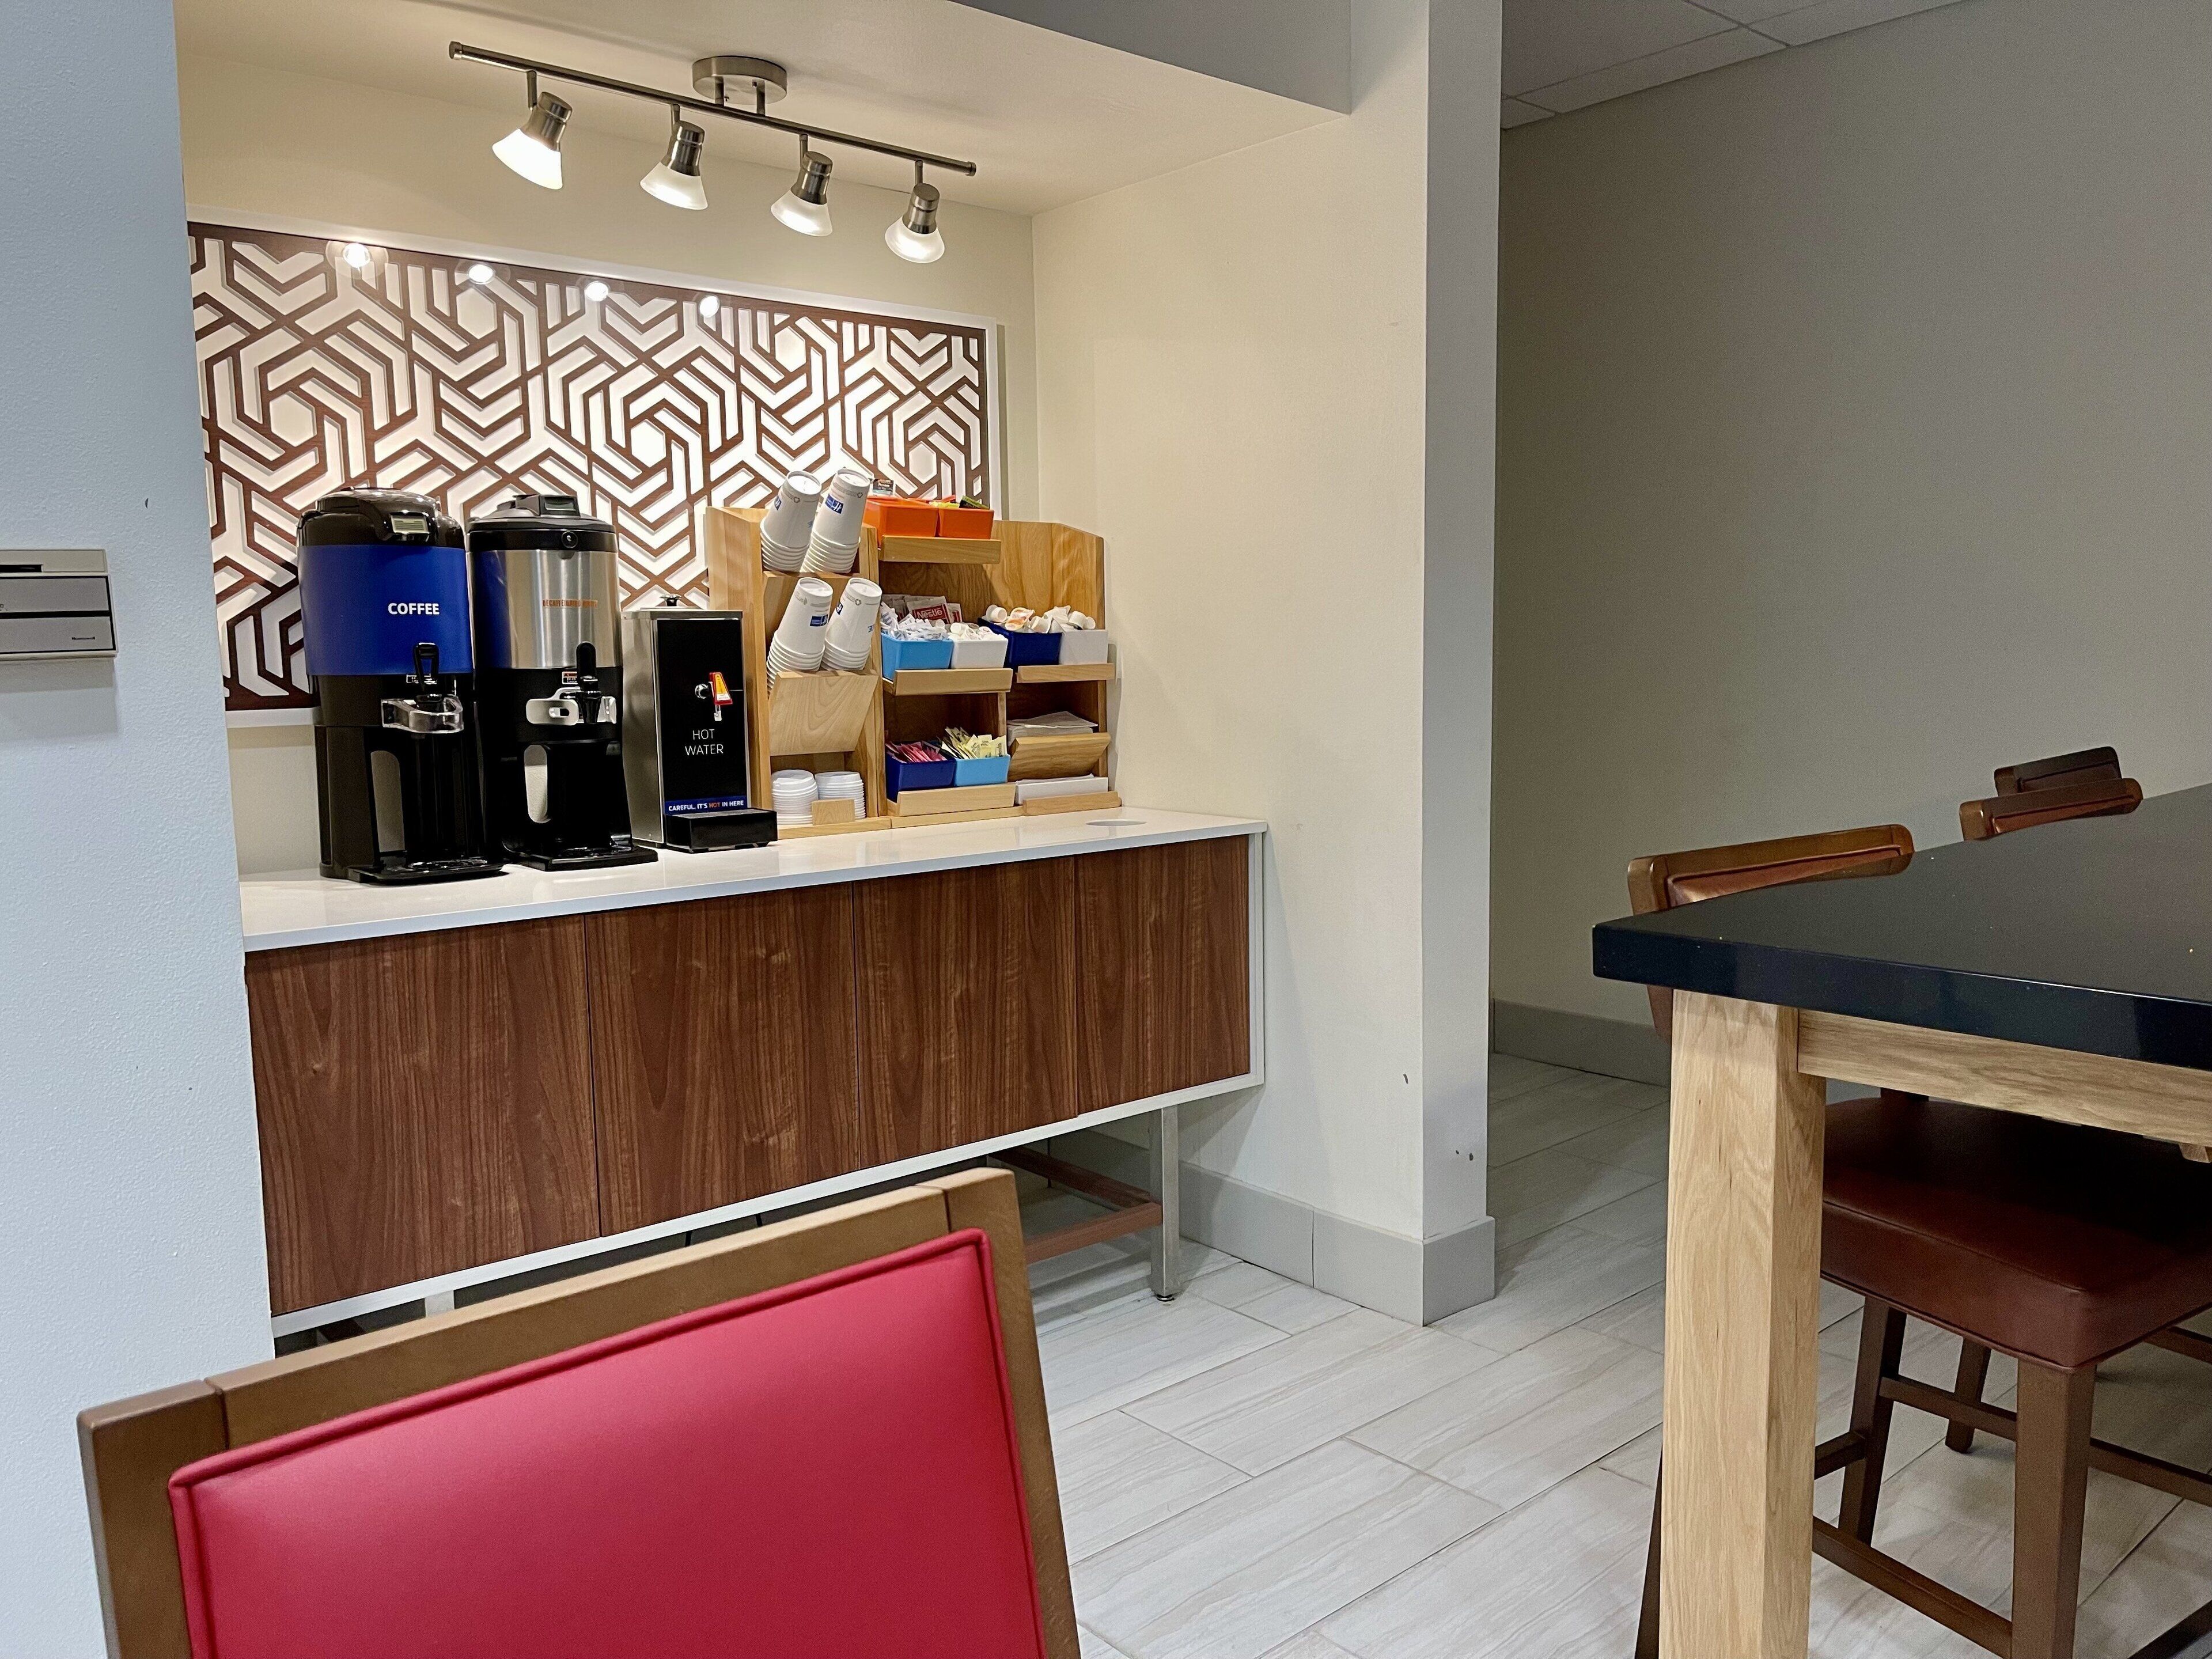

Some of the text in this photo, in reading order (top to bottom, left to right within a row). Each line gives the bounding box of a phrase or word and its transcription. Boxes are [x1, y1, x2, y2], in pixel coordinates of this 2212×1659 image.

[388, 603, 440, 615] COFFEE
[692, 729, 715, 740] HOT
[684, 744, 724, 756] WATER
